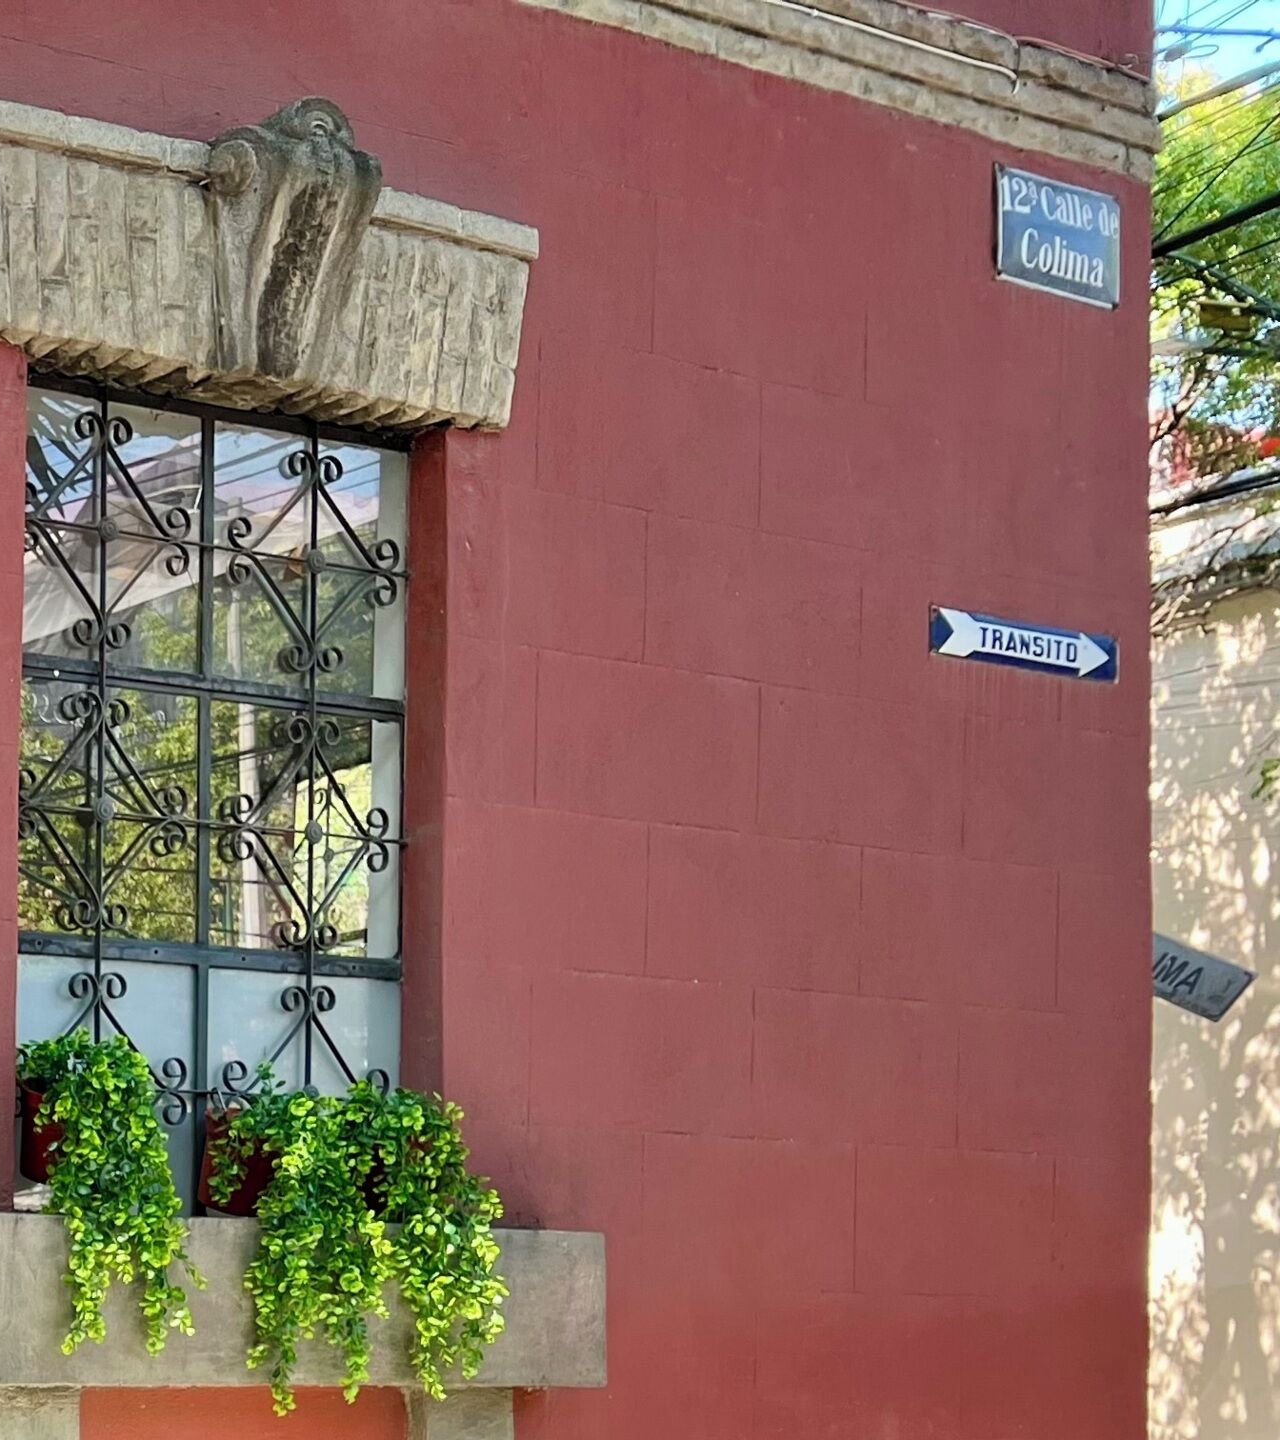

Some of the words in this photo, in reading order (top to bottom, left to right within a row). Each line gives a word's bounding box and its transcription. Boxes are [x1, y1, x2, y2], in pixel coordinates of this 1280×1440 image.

[1040, 186, 1093, 231] Calle
[1098, 202, 1120, 239] de
[1021, 228, 1104, 288] Colima
[979, 626, 1078, 663] TRANSITO
